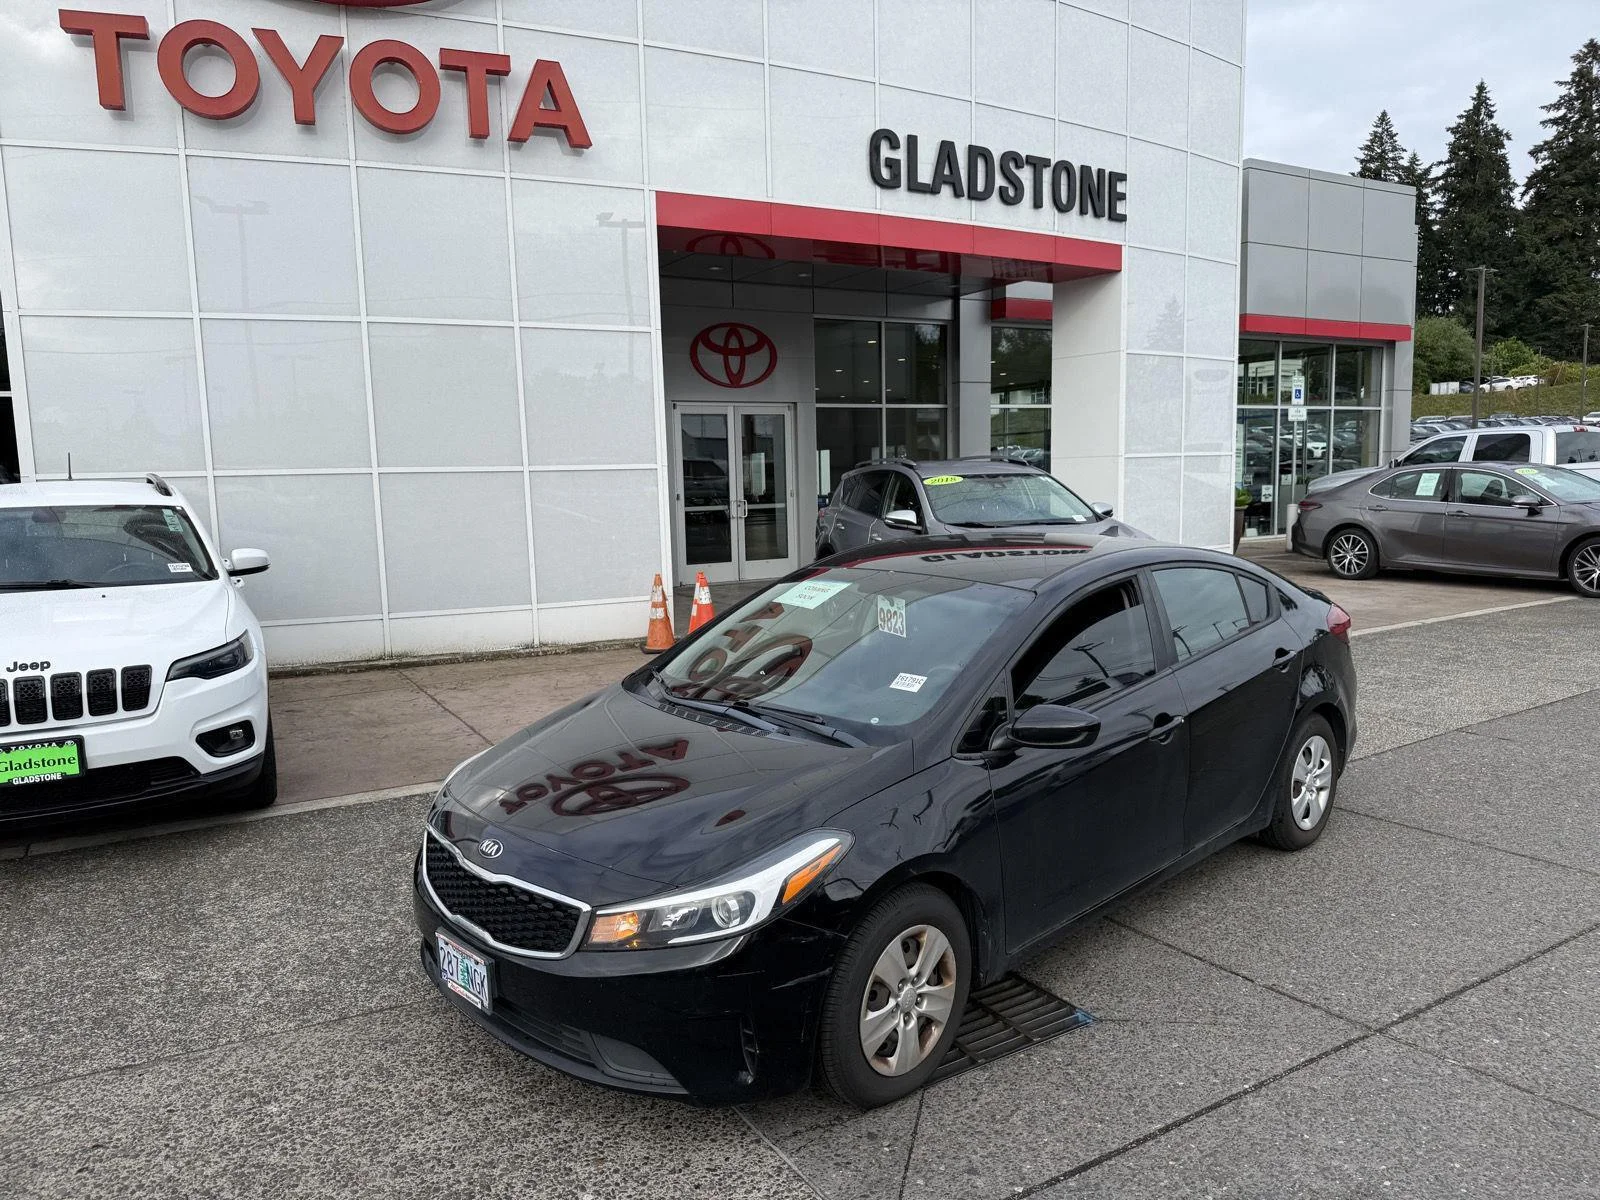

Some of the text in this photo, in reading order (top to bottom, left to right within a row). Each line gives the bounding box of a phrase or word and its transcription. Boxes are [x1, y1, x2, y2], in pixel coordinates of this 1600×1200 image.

[58, 8, 593, 149] TOYOTA
[869, 128, 1128, 222] GLADSTONE
[879, 607, 905, 636] 9823
[6, 661, 51, 673] Jeep
[11, 742, 57, 751] TOYOTA
[0, 756, 76, 773] Gladstone
[13, 772, 62, 785] GLADSTONE
[480, 840, 499, 856] KIA
[440, 946, 459, 981] 287
[466, 962, 488, 1002] NGK
